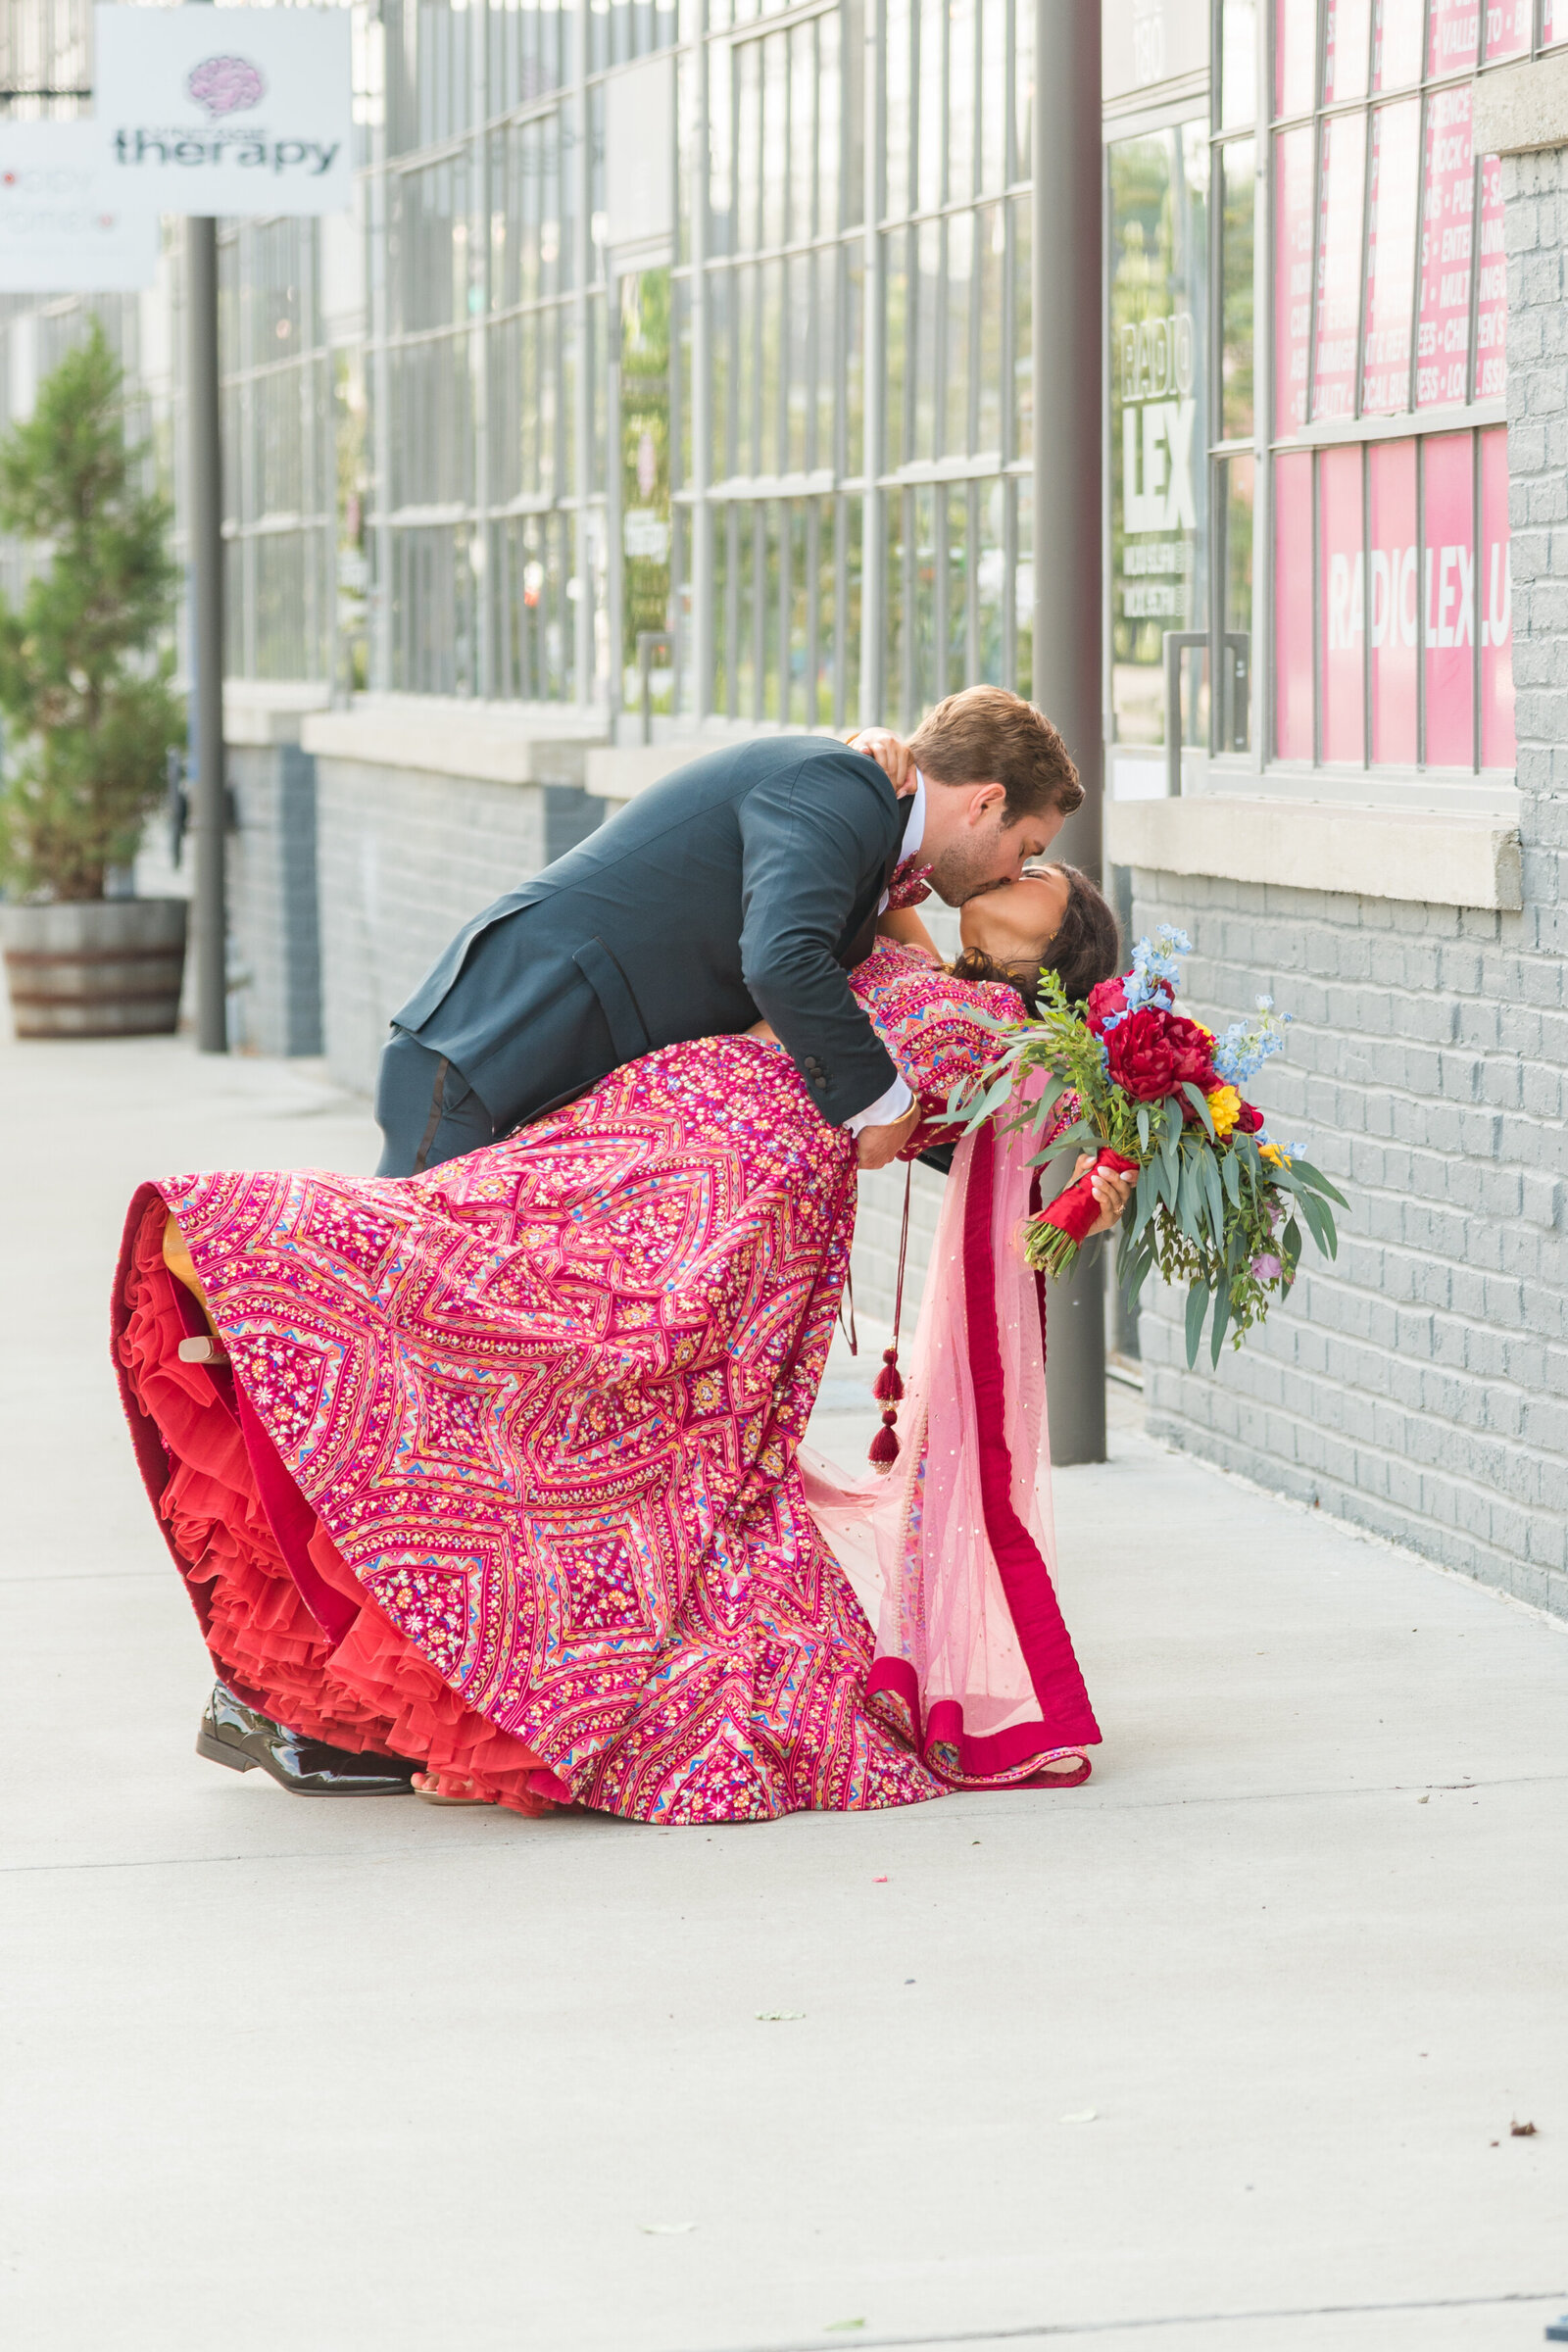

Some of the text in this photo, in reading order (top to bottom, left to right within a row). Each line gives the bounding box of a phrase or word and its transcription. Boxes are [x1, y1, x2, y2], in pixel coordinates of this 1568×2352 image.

[113, 128, 341, 176] therapy
[1120, 311, 1195, 403] RADIO
[1122, 398, 1197, 534] LEX
